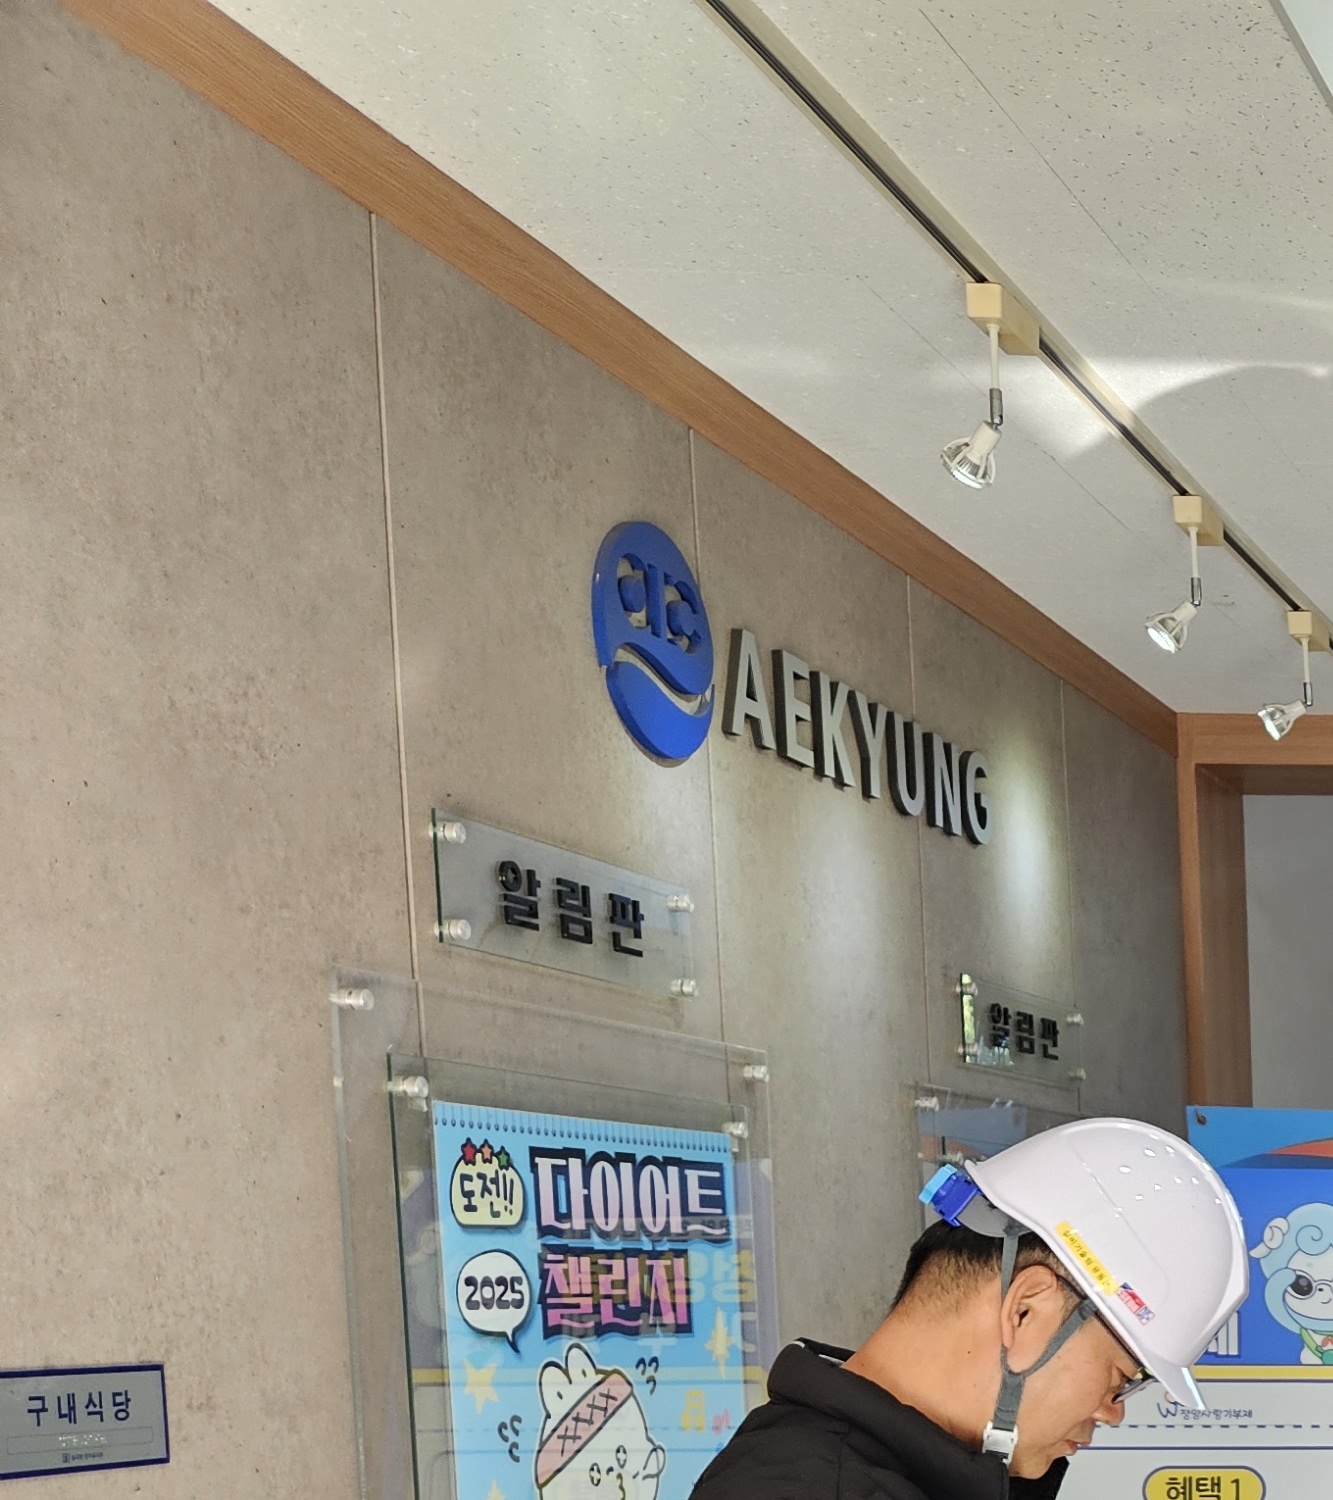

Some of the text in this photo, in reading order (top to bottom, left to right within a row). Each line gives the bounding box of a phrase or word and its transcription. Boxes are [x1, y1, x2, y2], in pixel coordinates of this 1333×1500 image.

[722, 628, 992, 845] AEKYUNG
[498, 860, 645, 957] 알림판
[990, 1003, 1060, 1061] 알림판
[459, 1170, 515, 1219] 도전!!
[530, 1150, 729, 1243] 다이어트
[463, 1275, 525, 1311] 2025
[543, 1252, 692, 1335] 챌린지
[27, 1390, 131, 1427] 구내식당
[1230, 1479, 1241, 1500] 1
